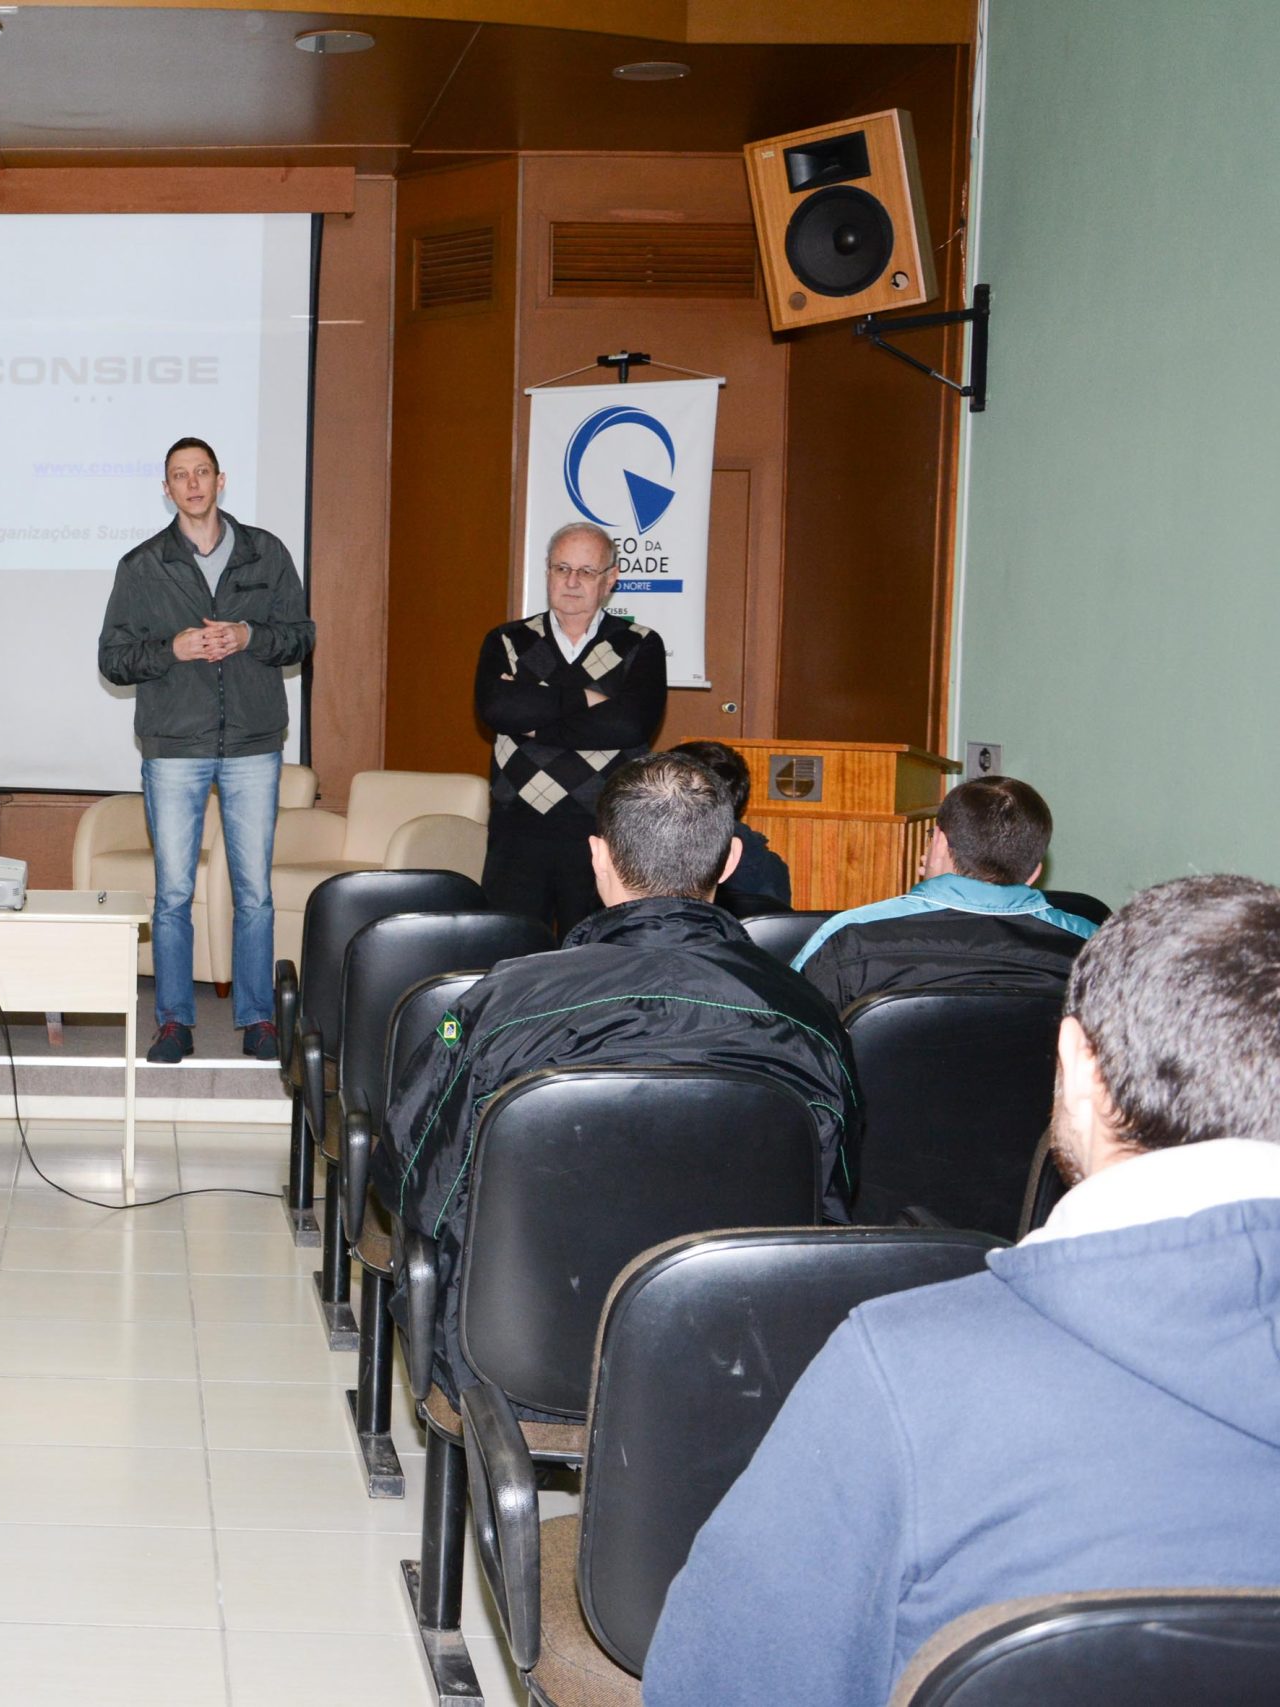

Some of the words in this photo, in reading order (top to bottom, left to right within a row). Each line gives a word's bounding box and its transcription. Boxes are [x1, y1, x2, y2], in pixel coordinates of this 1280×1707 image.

[32, 460, 165, 477] www.consige
[613, 537, 638, 554] EO
[645, 540, 662, 552] DA
[618, 556, 669, 573] DADE
[623, 581, 652, 591] NORTE
